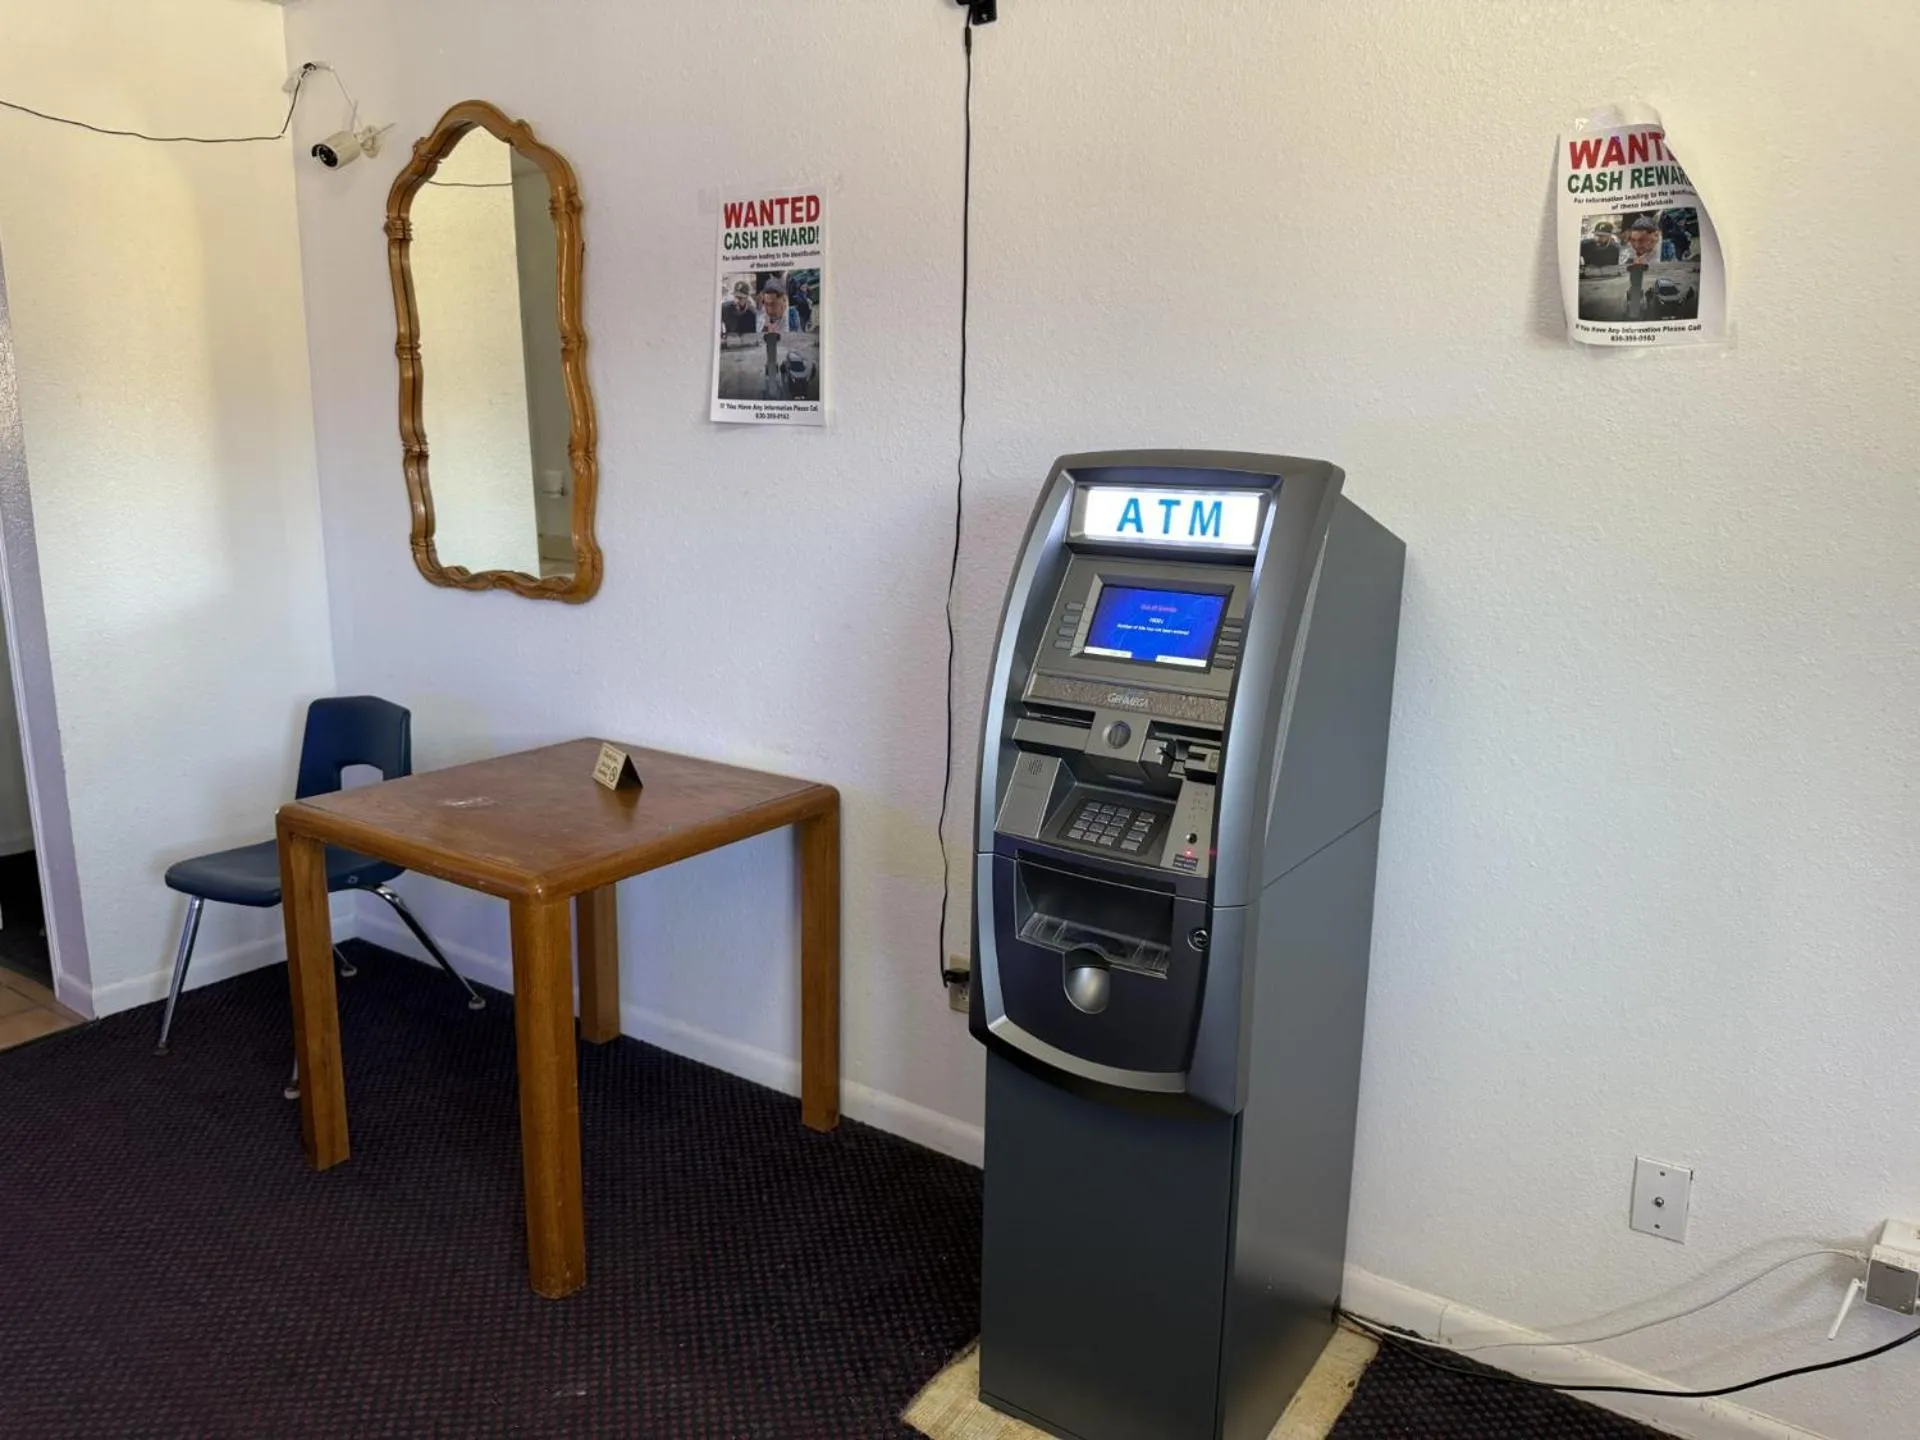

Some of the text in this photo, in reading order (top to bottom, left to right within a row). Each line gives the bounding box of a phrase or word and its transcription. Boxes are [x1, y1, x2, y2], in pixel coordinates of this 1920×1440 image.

[1568, 166, 1692, 193] CASH REWAR
[1625, 193, 1649, 202] leading
[724, 195, 820, 229] WANTED
[724, 226, 819, 250] CASH REWARD!
[1116, 497, 1222, 537] ATM
